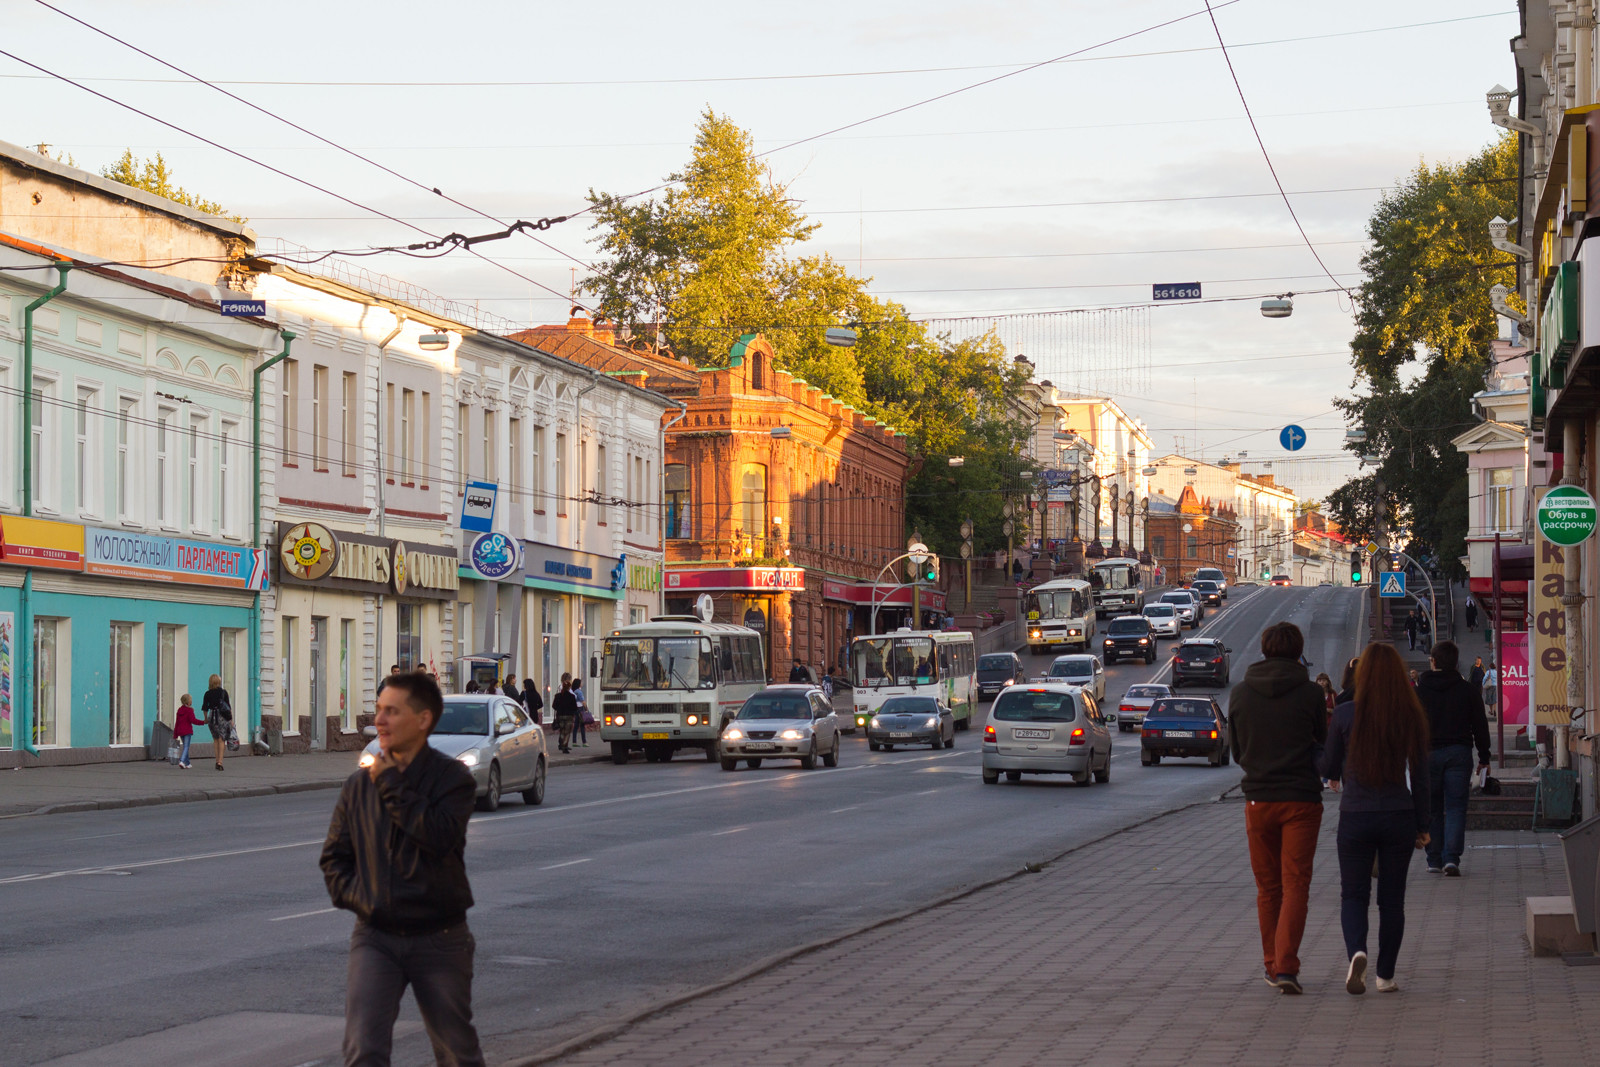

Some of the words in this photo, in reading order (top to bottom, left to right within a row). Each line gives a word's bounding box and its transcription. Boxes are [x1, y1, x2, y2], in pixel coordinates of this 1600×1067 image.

[222, 304, 264, 312] FORMA
[1548, 510, 1579, 521] Обувь
[1543, 521, 1594, 531] рассрочку
[94, 534, 172, 568] МОЛОДЁЖНЫЙ
[177, 545, 241, 575] ПАРЛАМЕНТ
[406, 551, 460, 591] COFFEE
[761, 571, 798, 587] РОМАН
[639, 640, 653, 652] 29
[1501, 665, 1530, 678] SAL
